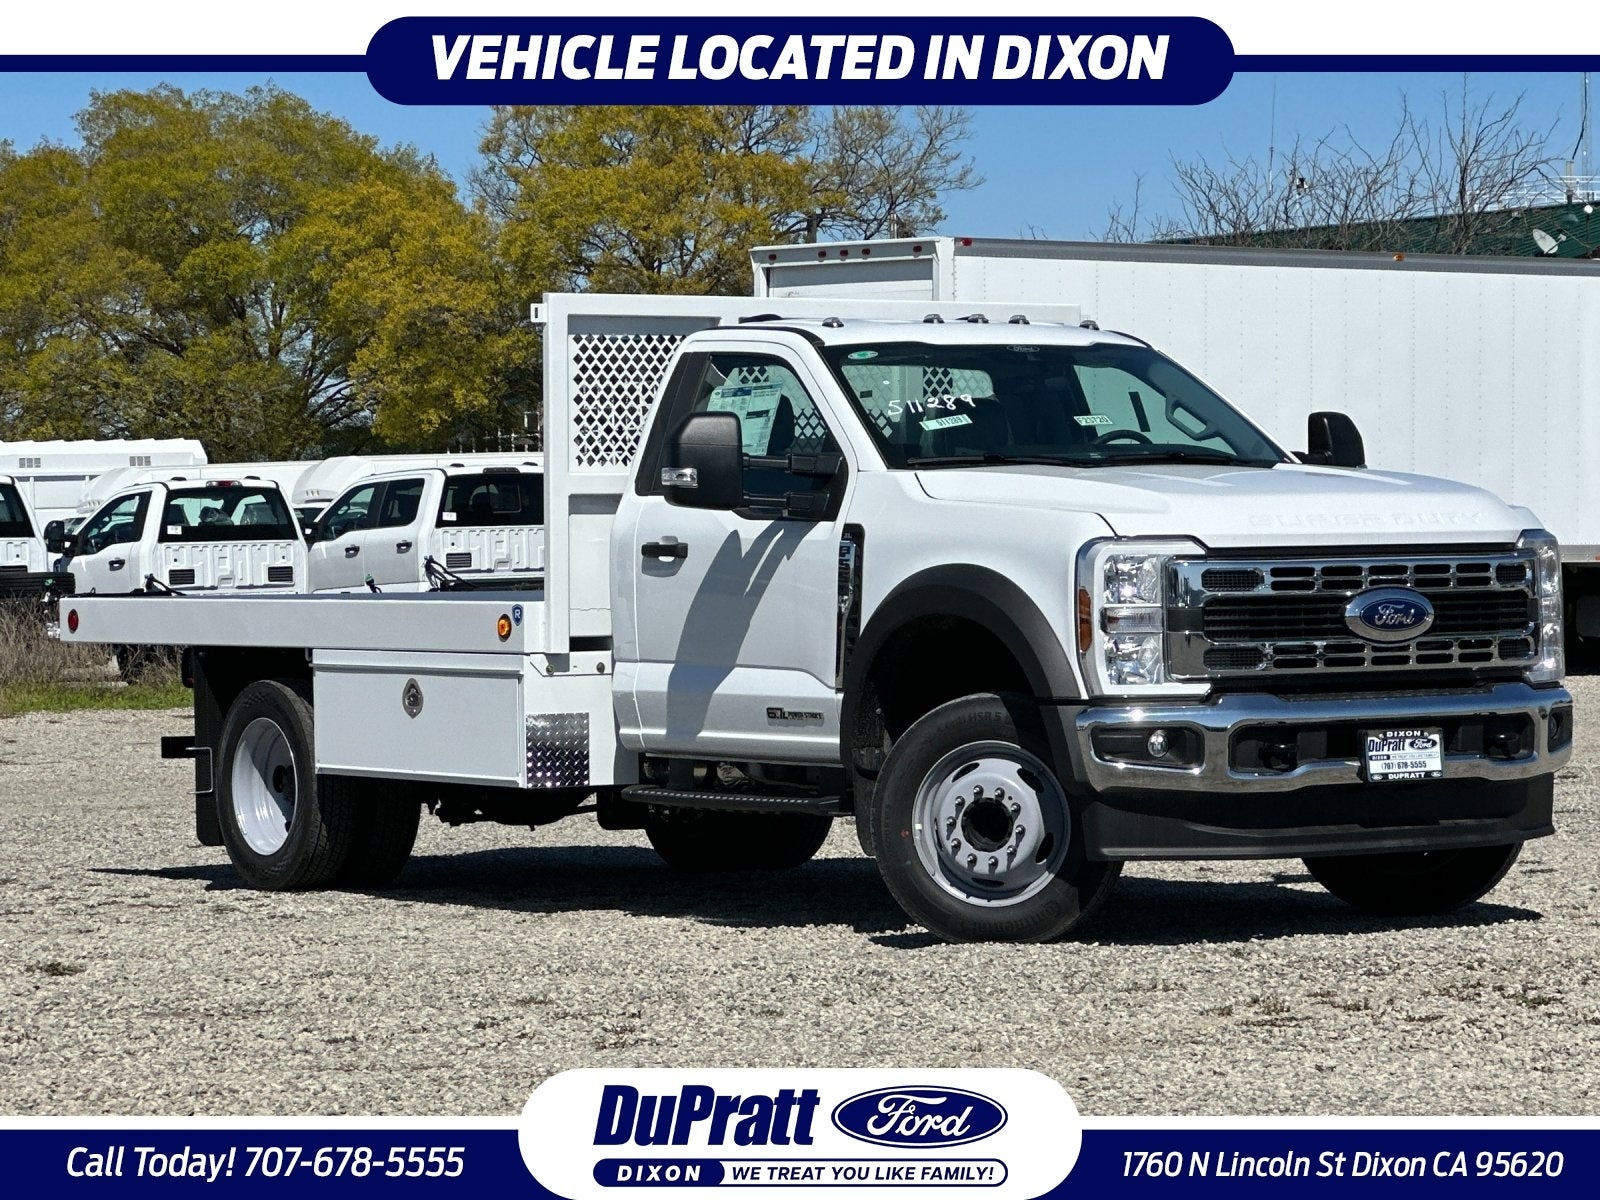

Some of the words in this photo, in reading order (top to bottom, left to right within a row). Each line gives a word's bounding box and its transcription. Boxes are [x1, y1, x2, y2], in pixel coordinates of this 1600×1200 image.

[1248, 512, 1381, 528] SUPER
[1391, 511, 1483, 526] DUTY
[1375, 603, 1415, 625] Ford
[1368, 739, 1405, 752] DuPratt
[1413, 739, 1433, 749] Ford
[1388, 772, 1426, 780] DUPRATT
